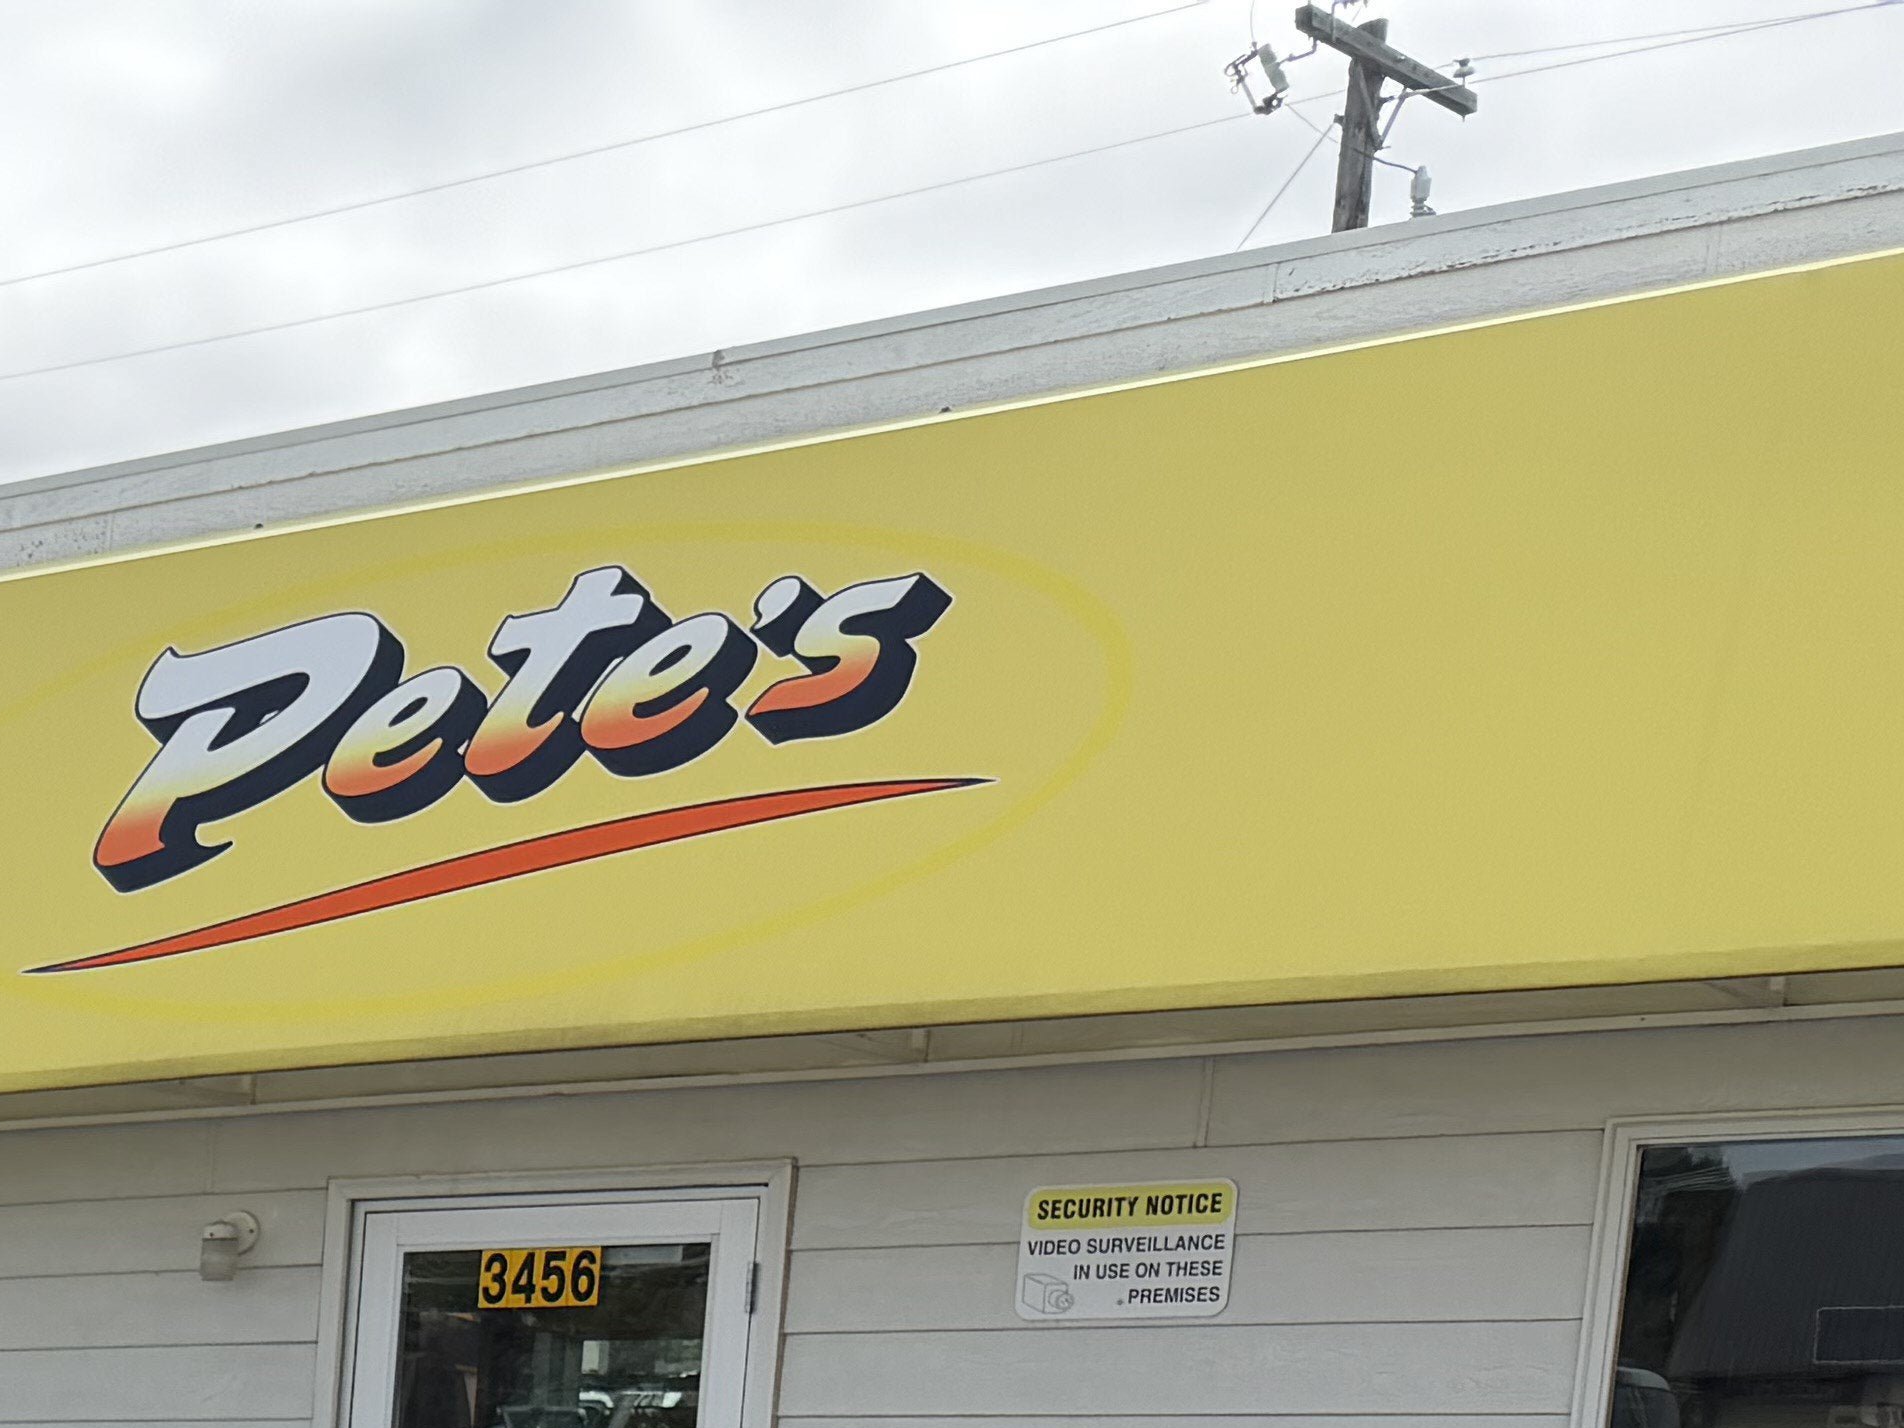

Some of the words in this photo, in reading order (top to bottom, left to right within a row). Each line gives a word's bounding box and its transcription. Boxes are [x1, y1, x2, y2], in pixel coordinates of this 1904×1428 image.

[92, 565, 953, 893] Pete's
[1036, 1196, 1137, 1222] SECURITY
[1146, 1191, 1224, 1217] NOTICE
[1026, 1239, 1082, 1257] VIDEO
[1085, 1233, 1226, 1255] SURVEILLANCE
[480, 1249, 598, 1306] 3456
[1072, 1264, 1092, 1281] IN
[1095, 1262, 1130, 1280] USE
[1134, 1261, 1161, 1279] ON
[1165, 1259, 1224, 1278] THESE
[1127, 1285, 1221, 1305] PREMISES
